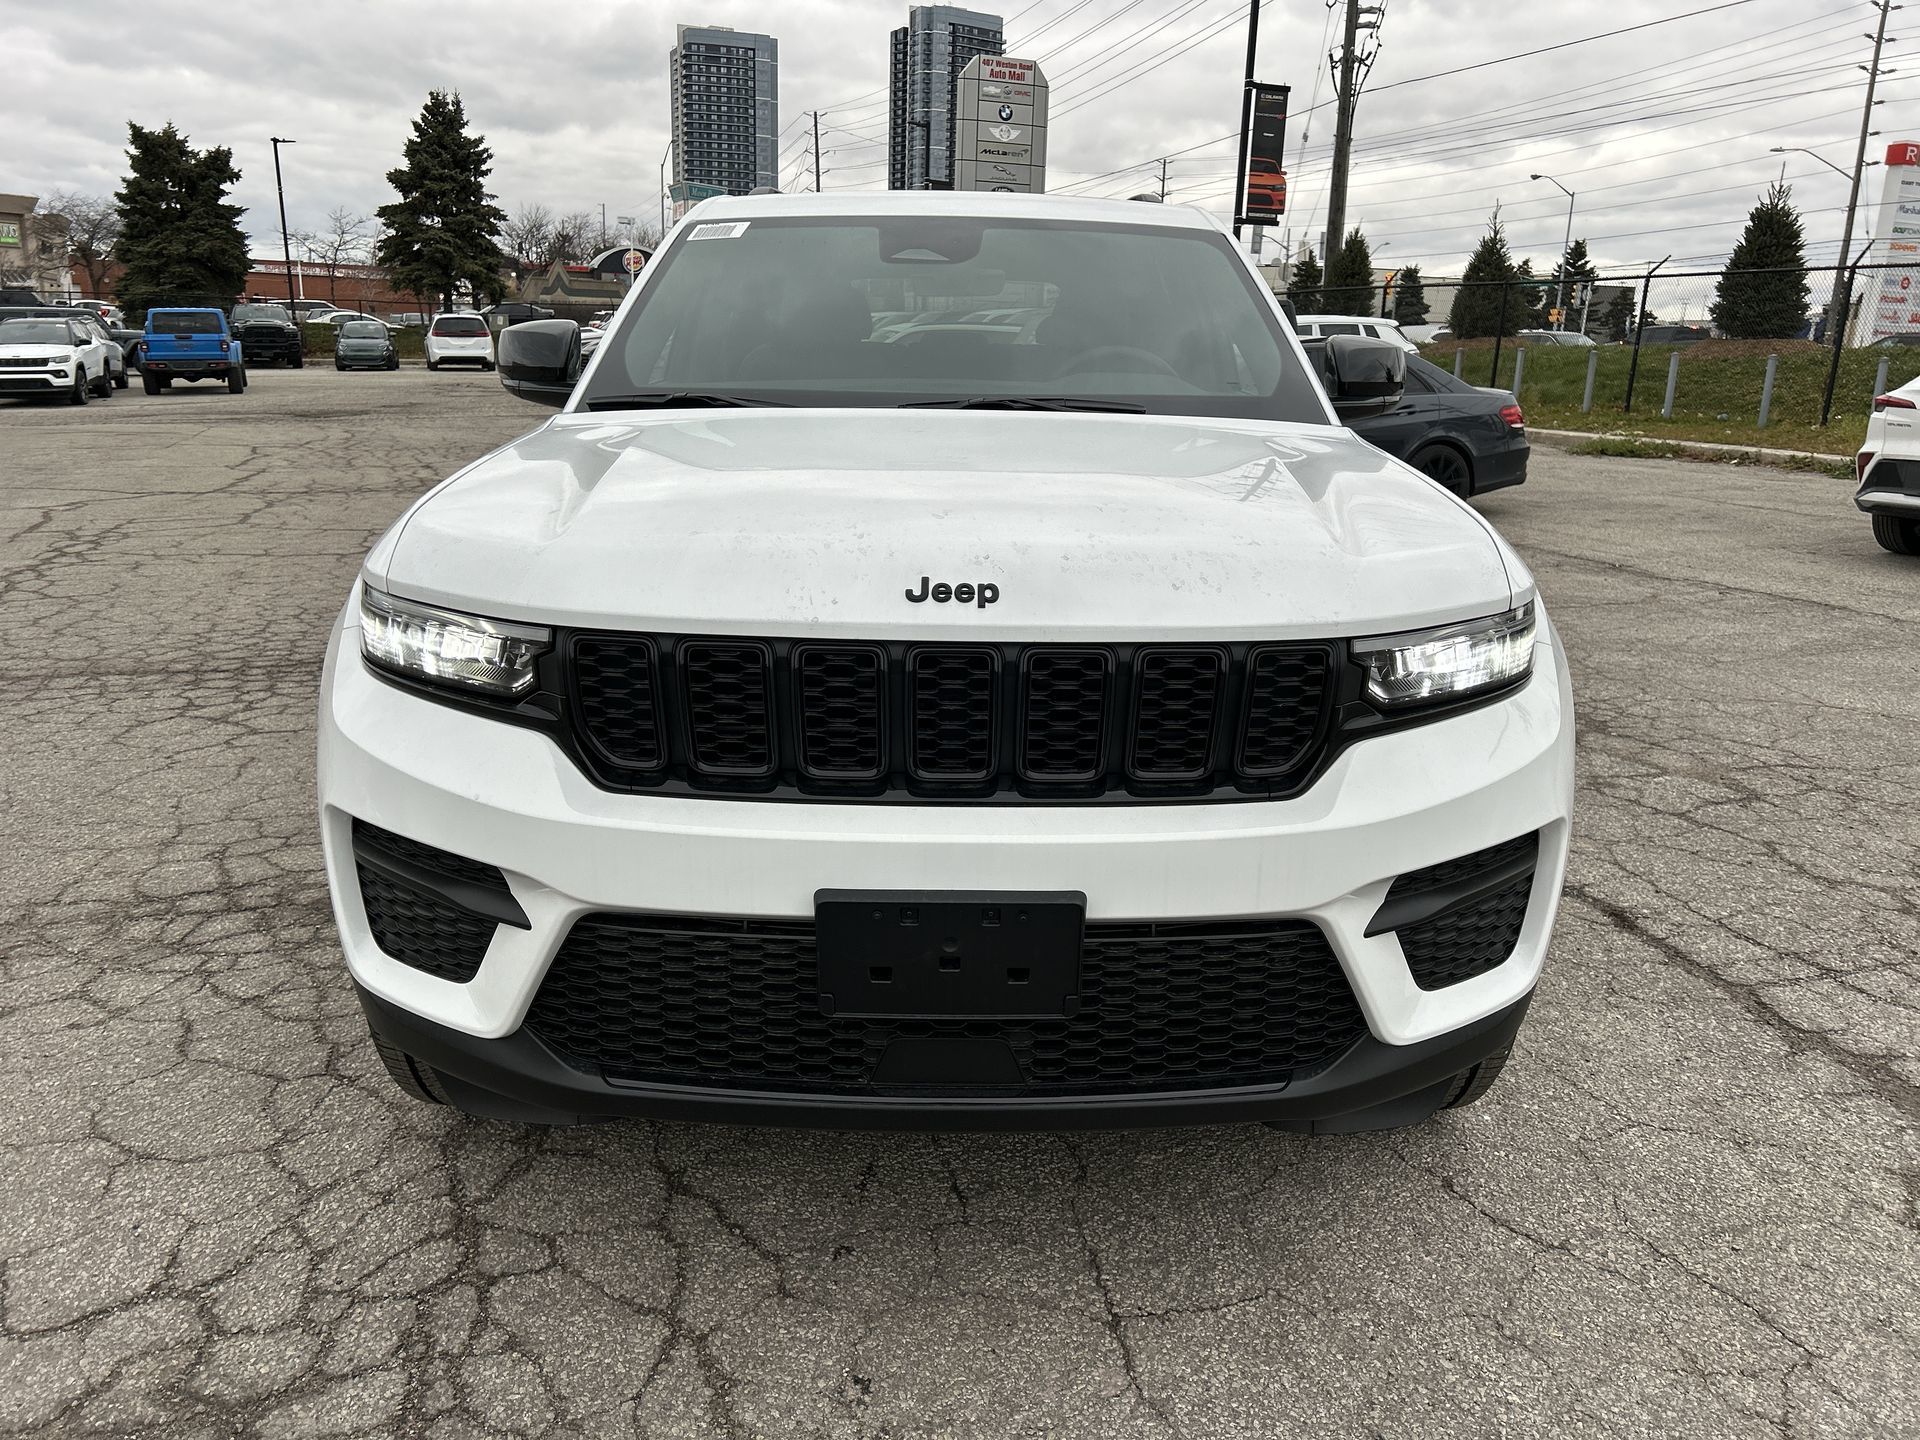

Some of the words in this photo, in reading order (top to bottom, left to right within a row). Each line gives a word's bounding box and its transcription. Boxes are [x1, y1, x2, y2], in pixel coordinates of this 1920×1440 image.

[996, 60, 1017, 69] Weston
[1019, 63, 1033, 71] Road
[990, 69, 1006, 79] Auto
[1008, 71, 1025, 81] Mall
[980, 148, 1024, 158] McLaren
[905, 576, 1000, 608] Jeep
